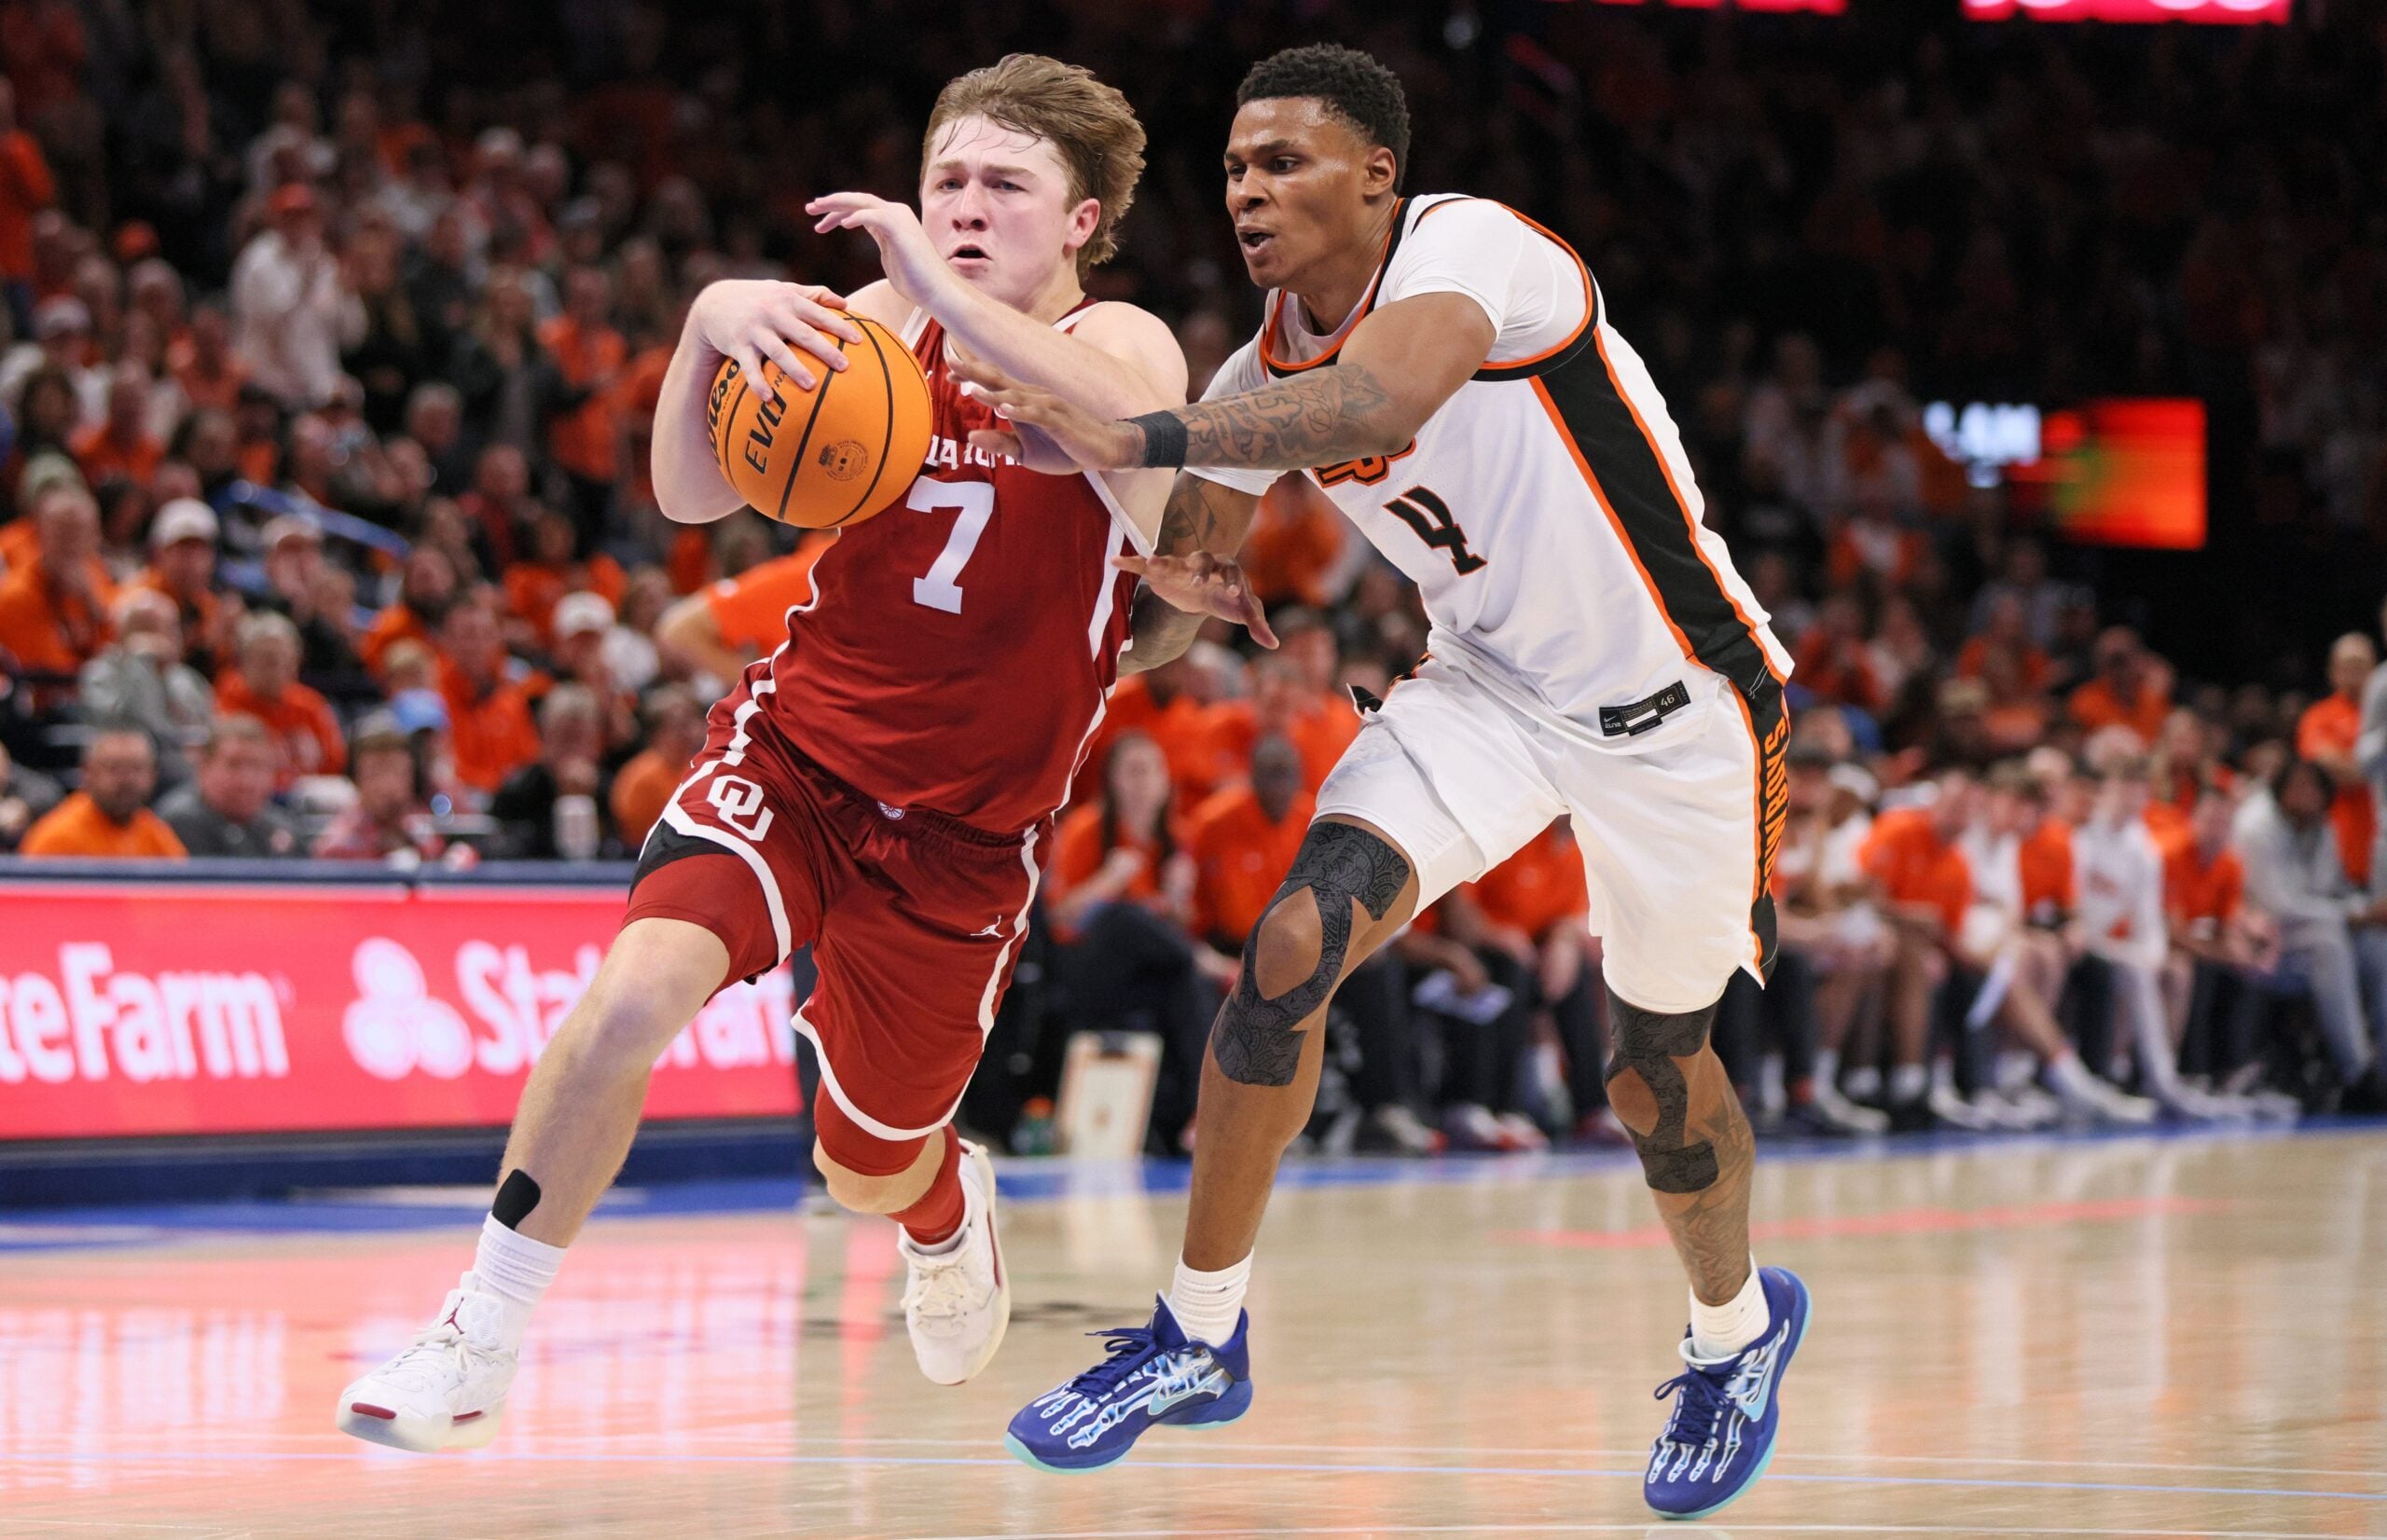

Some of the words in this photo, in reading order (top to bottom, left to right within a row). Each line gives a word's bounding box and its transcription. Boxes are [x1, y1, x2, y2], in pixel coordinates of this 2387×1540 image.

[907, 475, 995, 614] 7
[1383, 485, 1487, 576] 4
[1661, 694, 1675, 707] 46
[1763, 716, 1787, 898] OWBOYS
